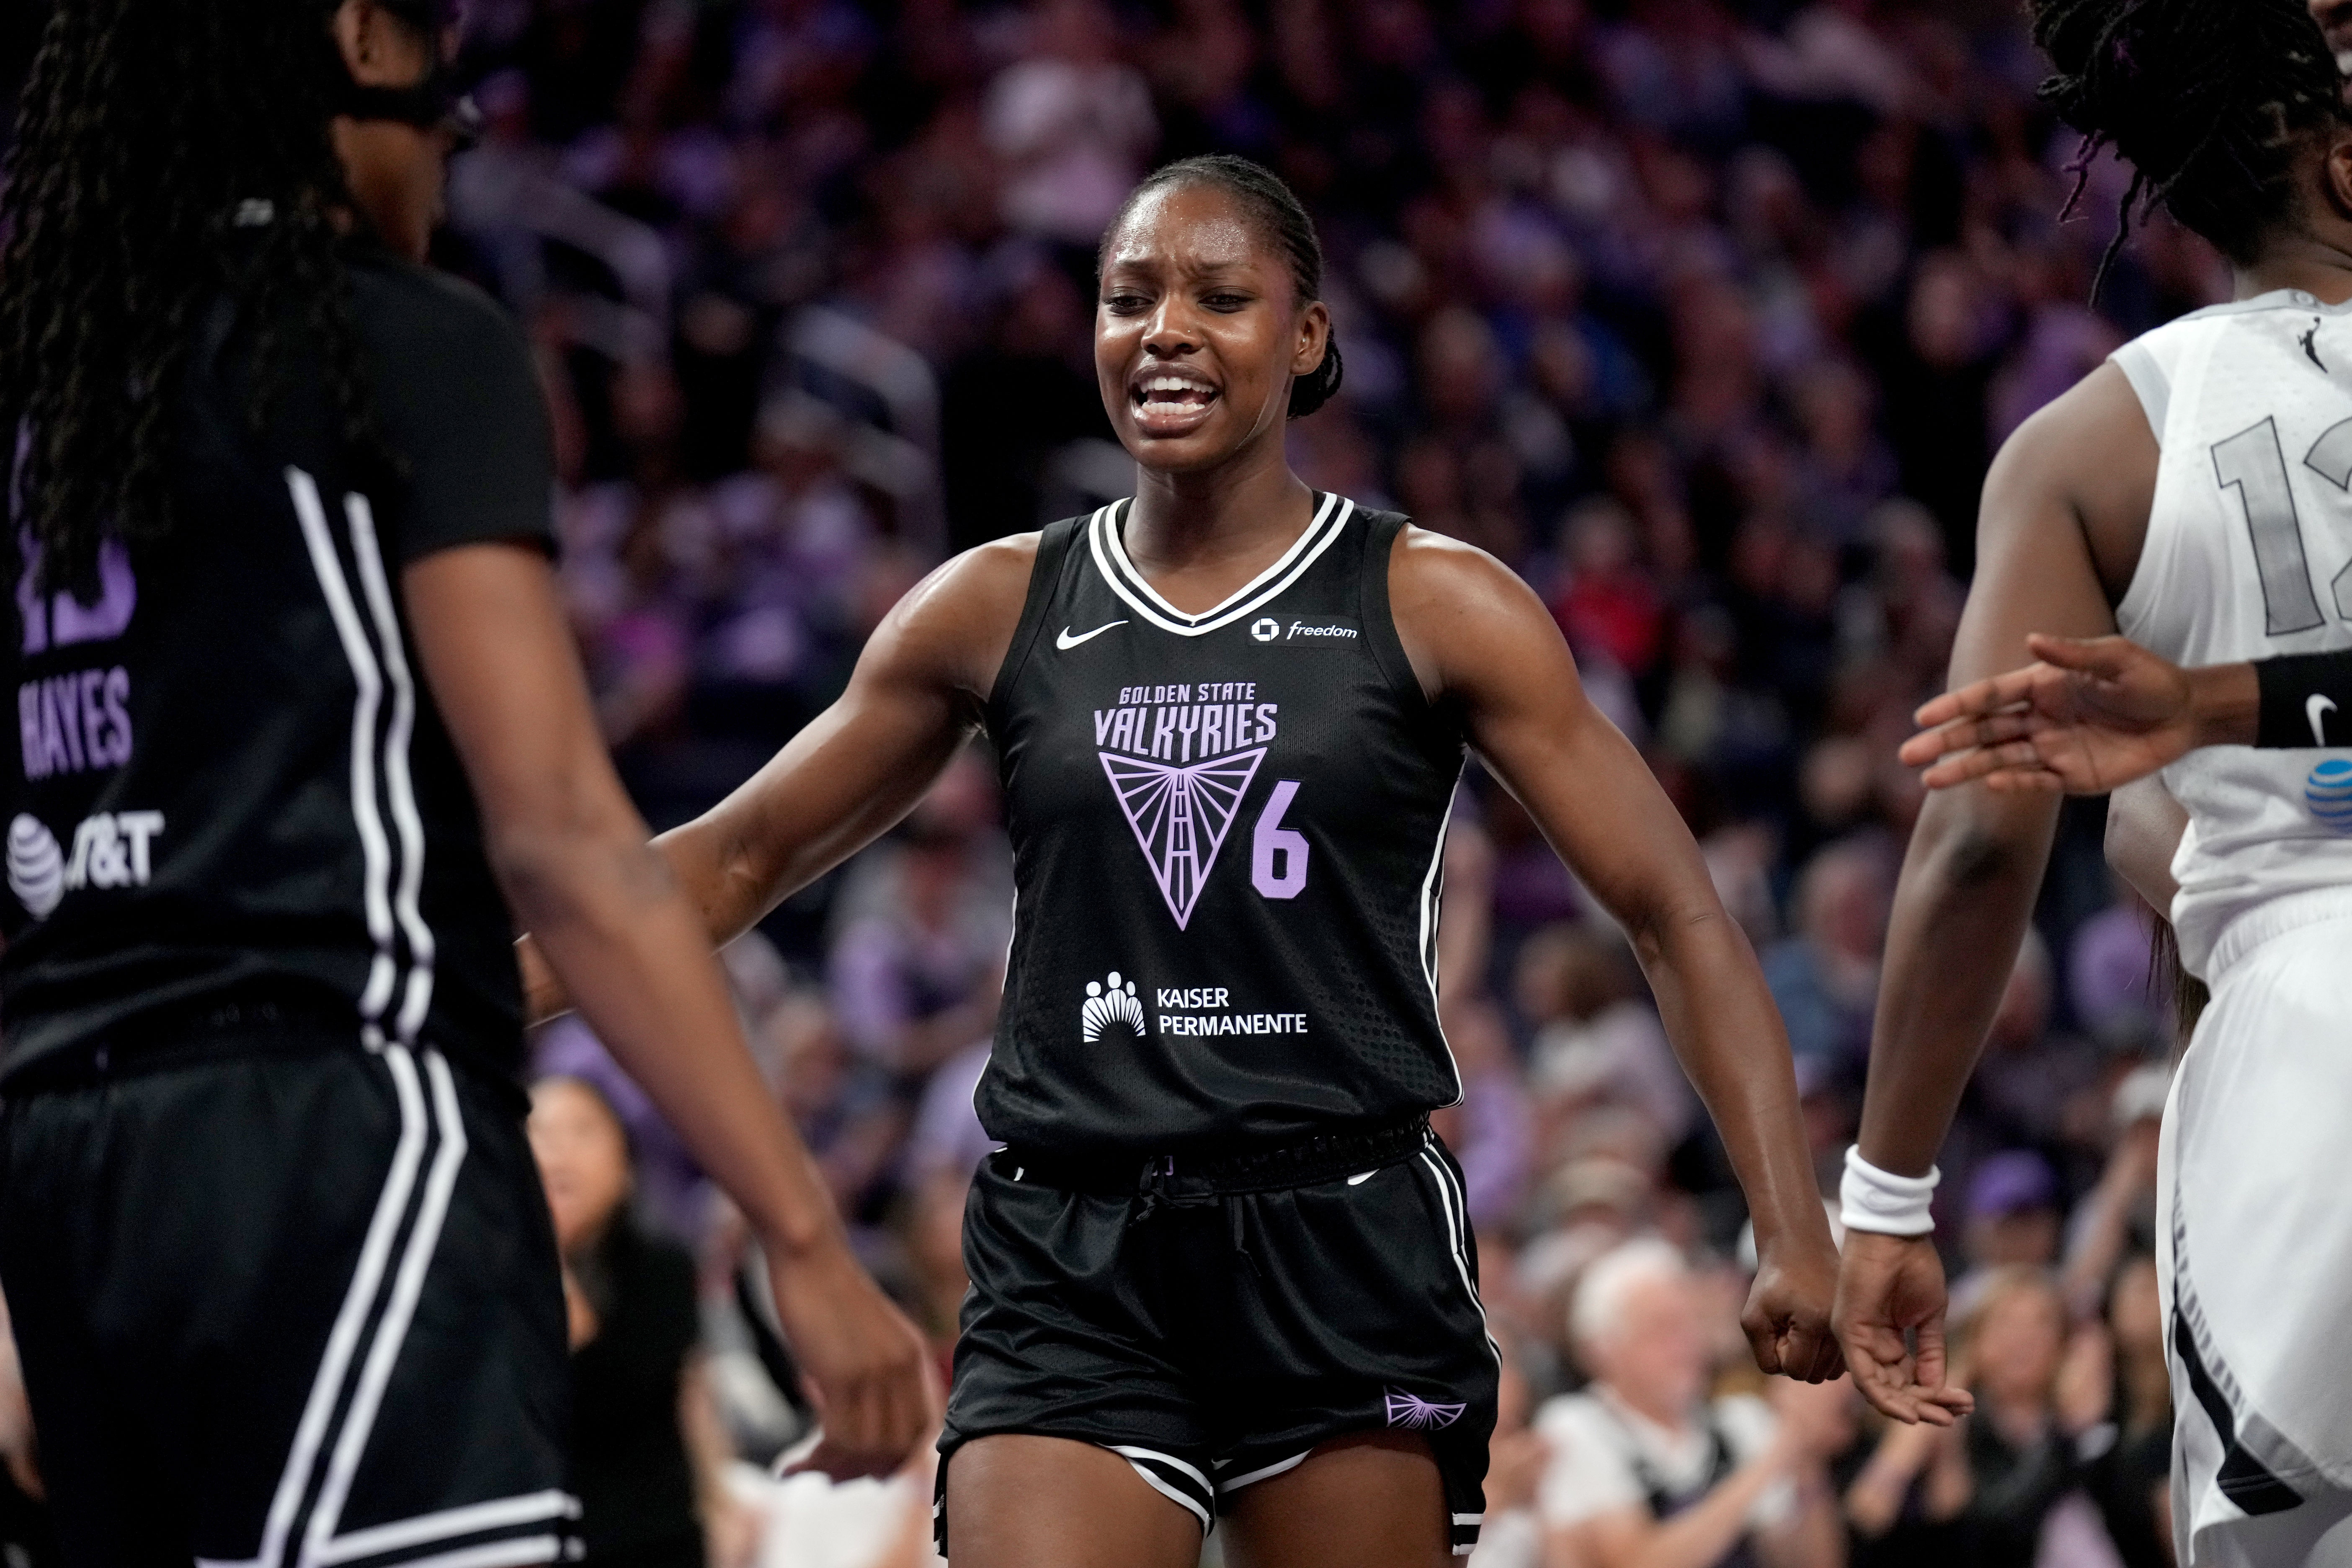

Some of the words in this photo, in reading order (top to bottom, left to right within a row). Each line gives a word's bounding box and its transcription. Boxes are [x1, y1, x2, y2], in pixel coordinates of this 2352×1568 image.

[1287, 621, 1357, 640] freedom
[1119, 684, 1191, 705] GOLDEN
[1197, 682, 1256, 702] STATE
[1094, 703, 1278, 763] VALKYRIES
[1251, 779, 1310, 900] 6
[1157, 988, 1229, 1008] KAISER
[1159, 1014, 1308, 1036] PERMANENTE
